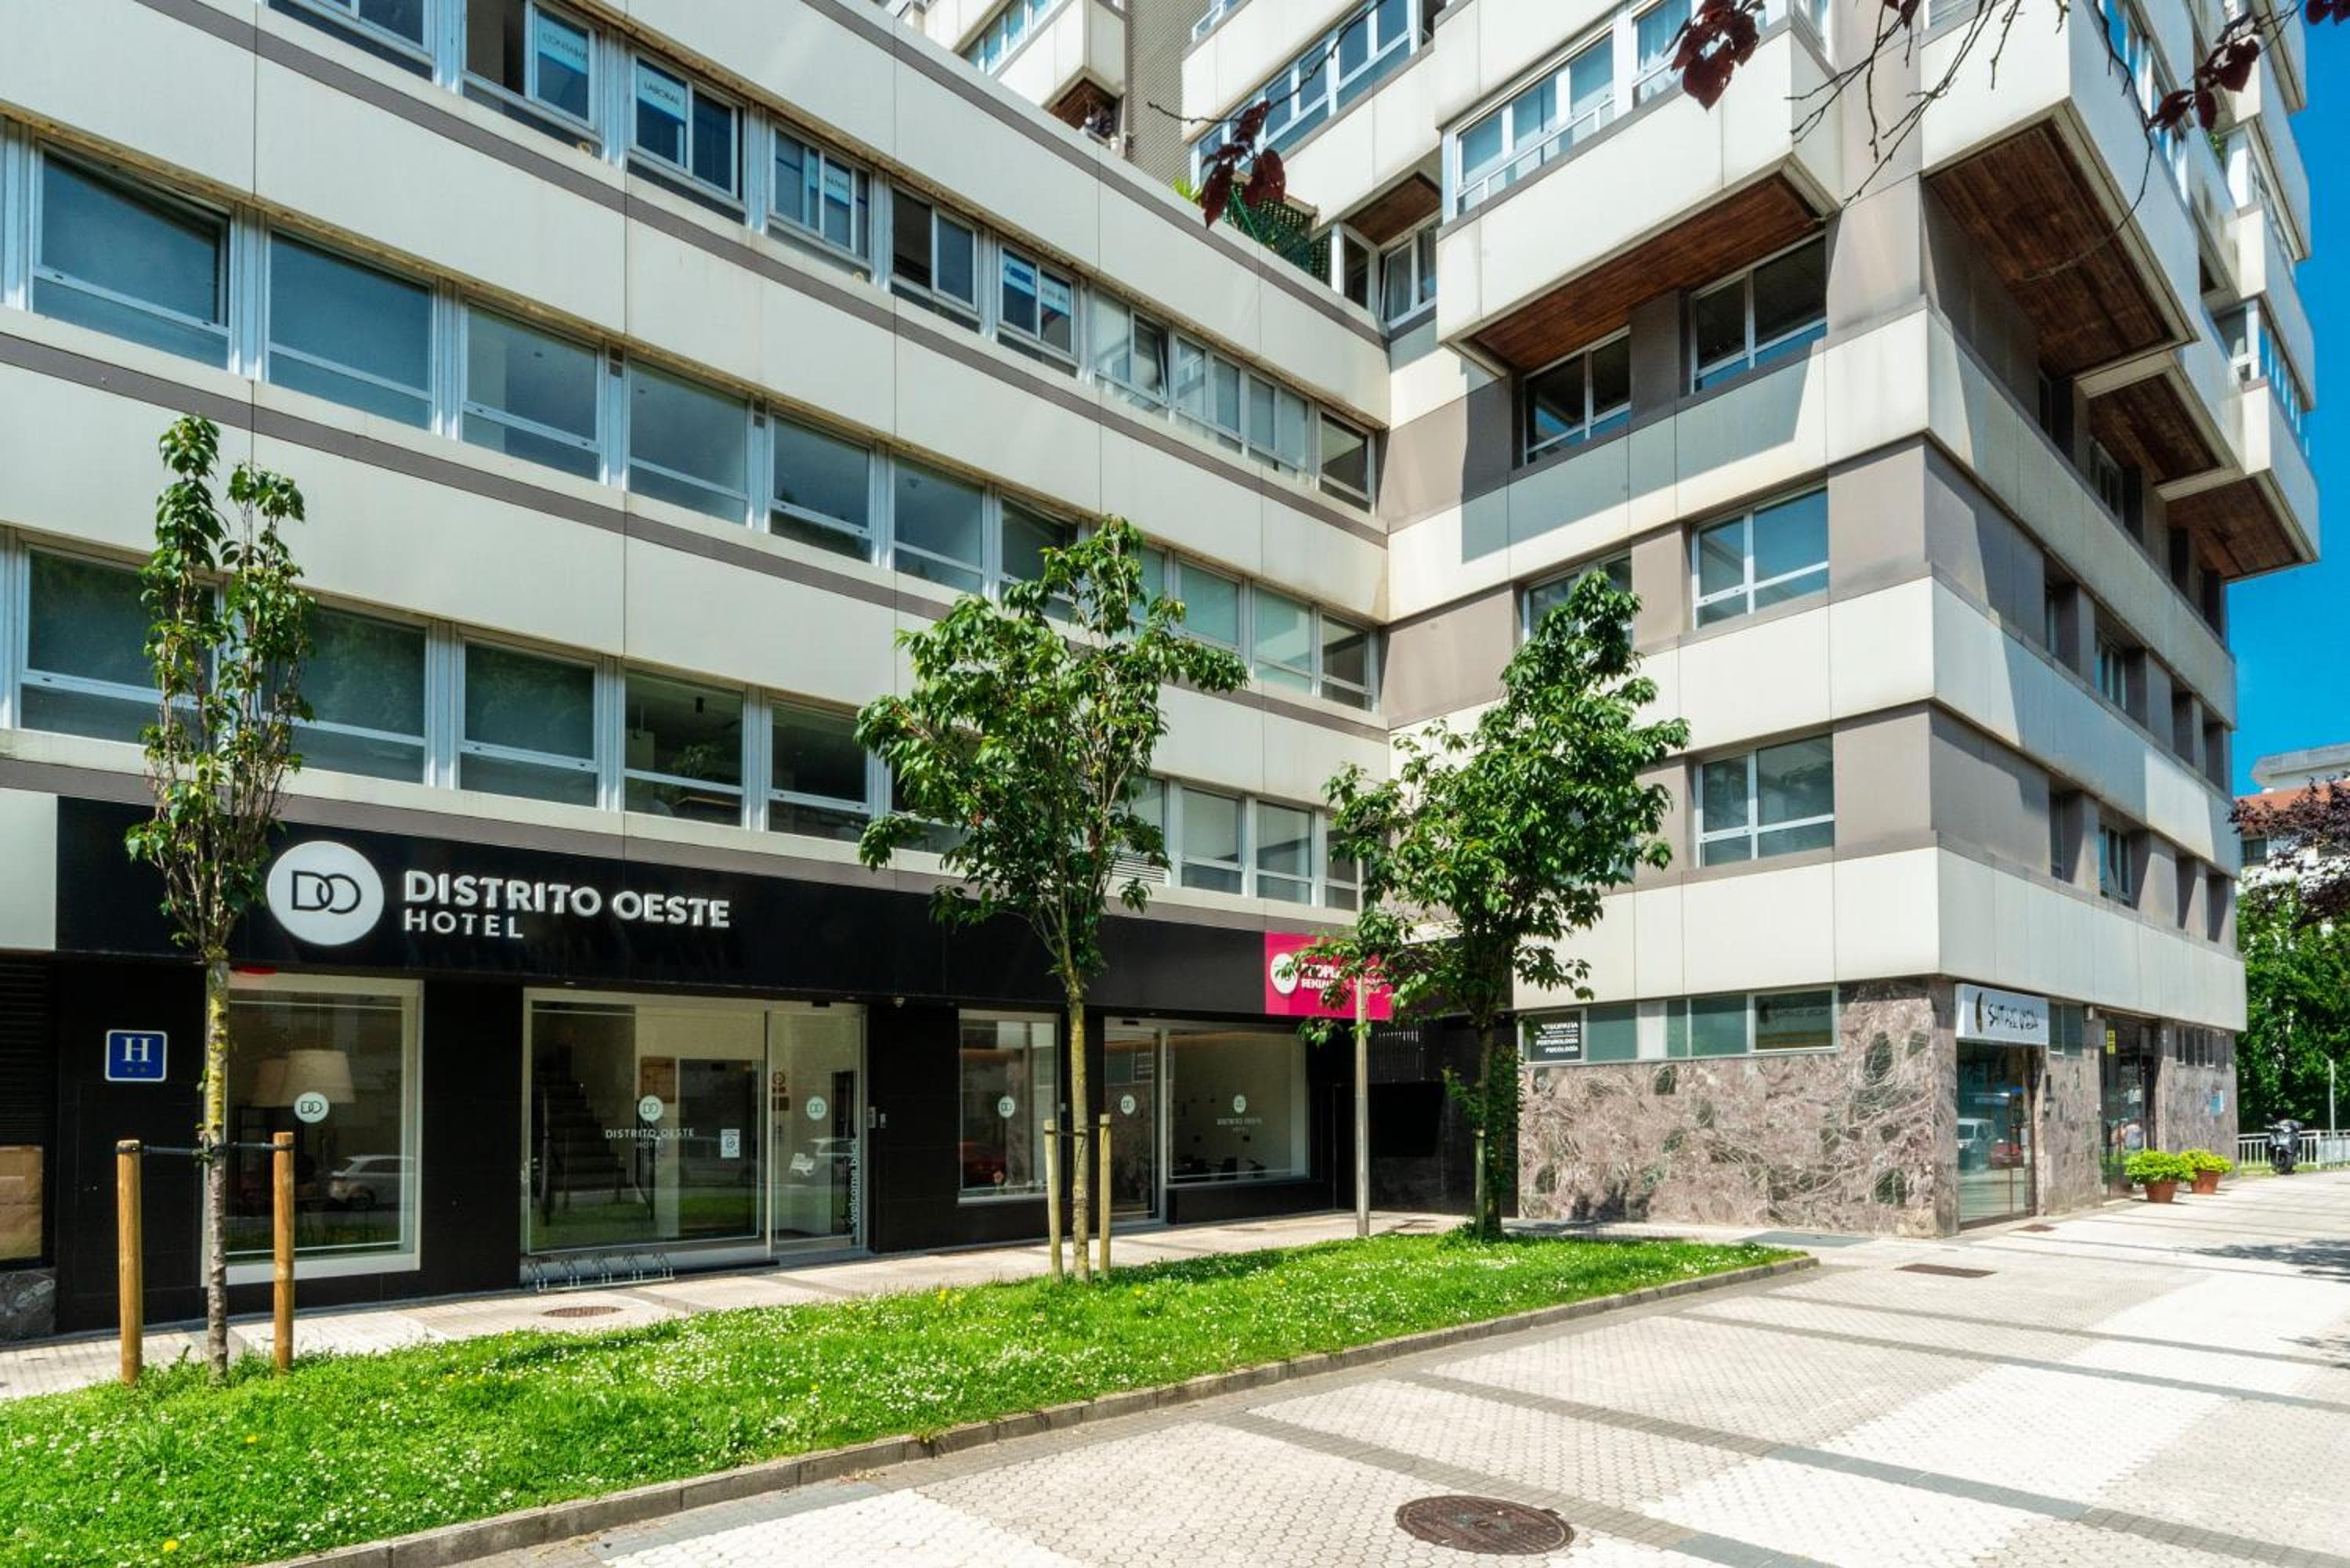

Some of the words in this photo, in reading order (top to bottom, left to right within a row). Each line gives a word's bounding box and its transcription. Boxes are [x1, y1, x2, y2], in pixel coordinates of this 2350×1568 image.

[404, 869, 602, 917] DISTRITO
[612, 891, 730, 928] OESTE
[404, 907, 524, 939] HOTEL
[120, 1036, 154, 1063] H
[605, 1129, 656, 1139] DISTRITO
[660, 1128, 695, 1138] OESTE
